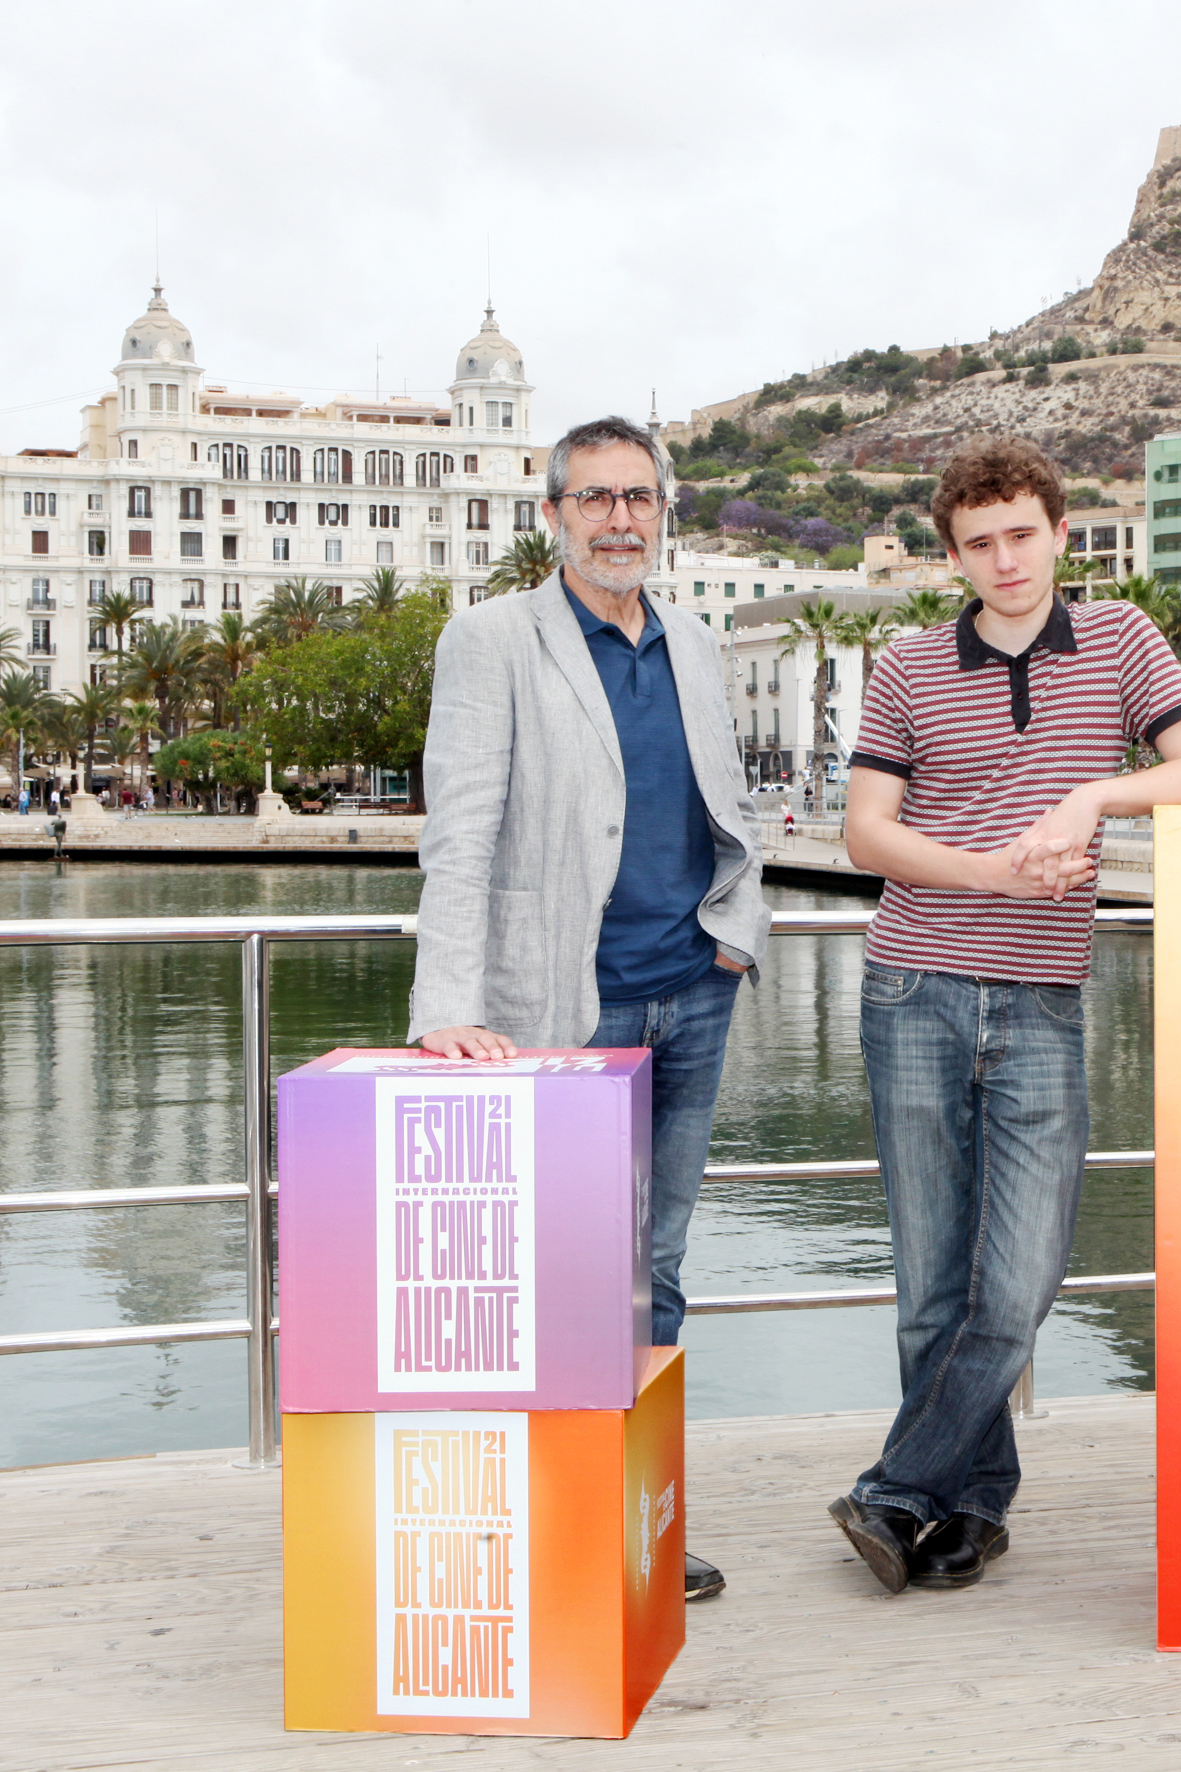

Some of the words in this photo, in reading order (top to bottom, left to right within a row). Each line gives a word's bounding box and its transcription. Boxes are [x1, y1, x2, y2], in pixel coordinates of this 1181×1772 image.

[394, 1095, 518, 1184] FESTIVAL
[395, 1187, 518, 1196] INTERNACIONAL
[394, 1200, 425, 1282] DE
[431, 1200, 487, 1281] CINE
[492, 1200, 519, 1281] DE
[394, 1286, 520, 1373] ALICANTE
[392, 1429, 512, 1516] FESTIVAL
[393, 1518, 512, 1529] INTERNACIONAL
[393, 1530, 422, 1609] DE
[428, 1531, 483, 1610] CINE
[487, 1532, 514, 1611] DE
[392, 1613, 514, 1699] ALICANTE
